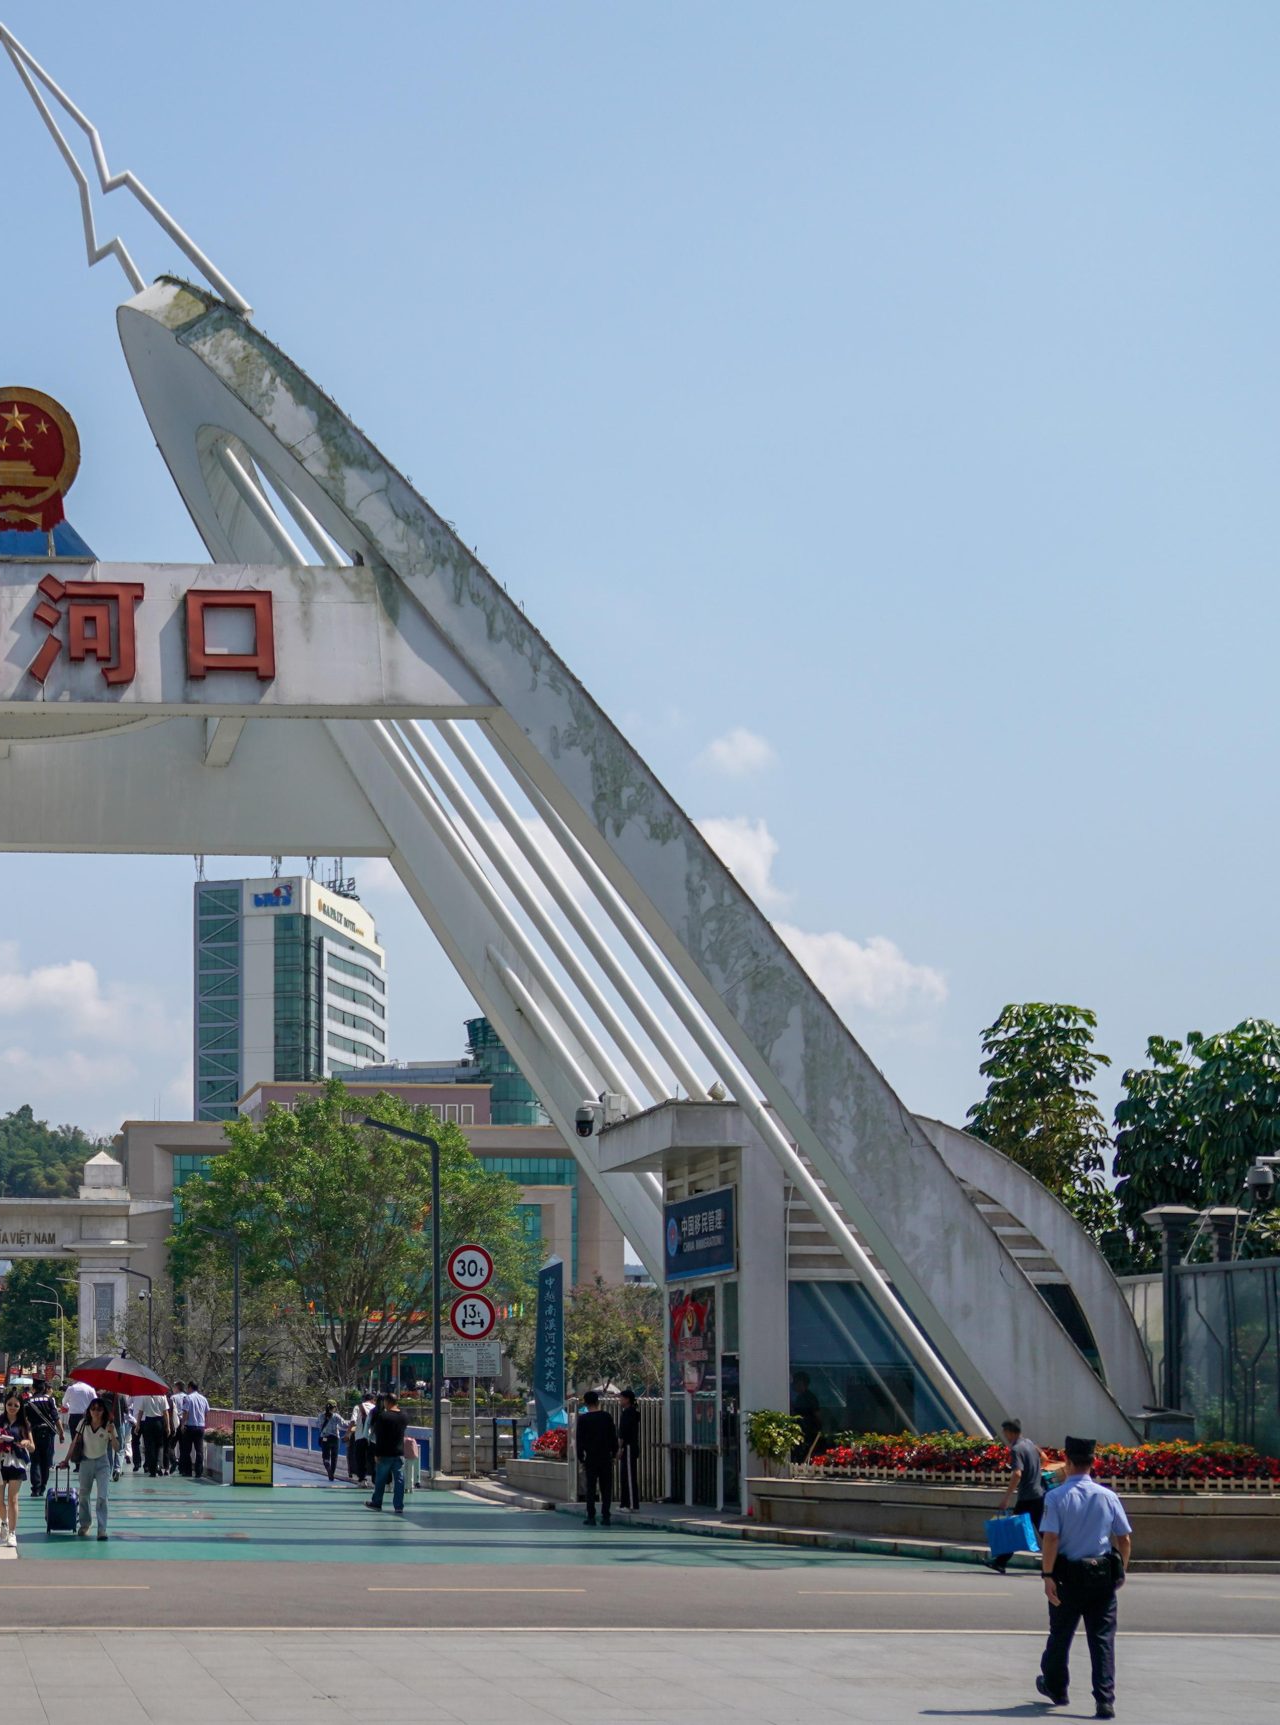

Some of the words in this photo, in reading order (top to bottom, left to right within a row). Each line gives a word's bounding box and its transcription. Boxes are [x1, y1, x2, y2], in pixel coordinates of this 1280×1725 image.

[681, 1208, 723, 1239] 中国移民管理
[9, 1229, 31, 1247] VIỆT
[33, 1232, 56, 1245] NAM
[682, 1240, 696, 1253] CHINA
